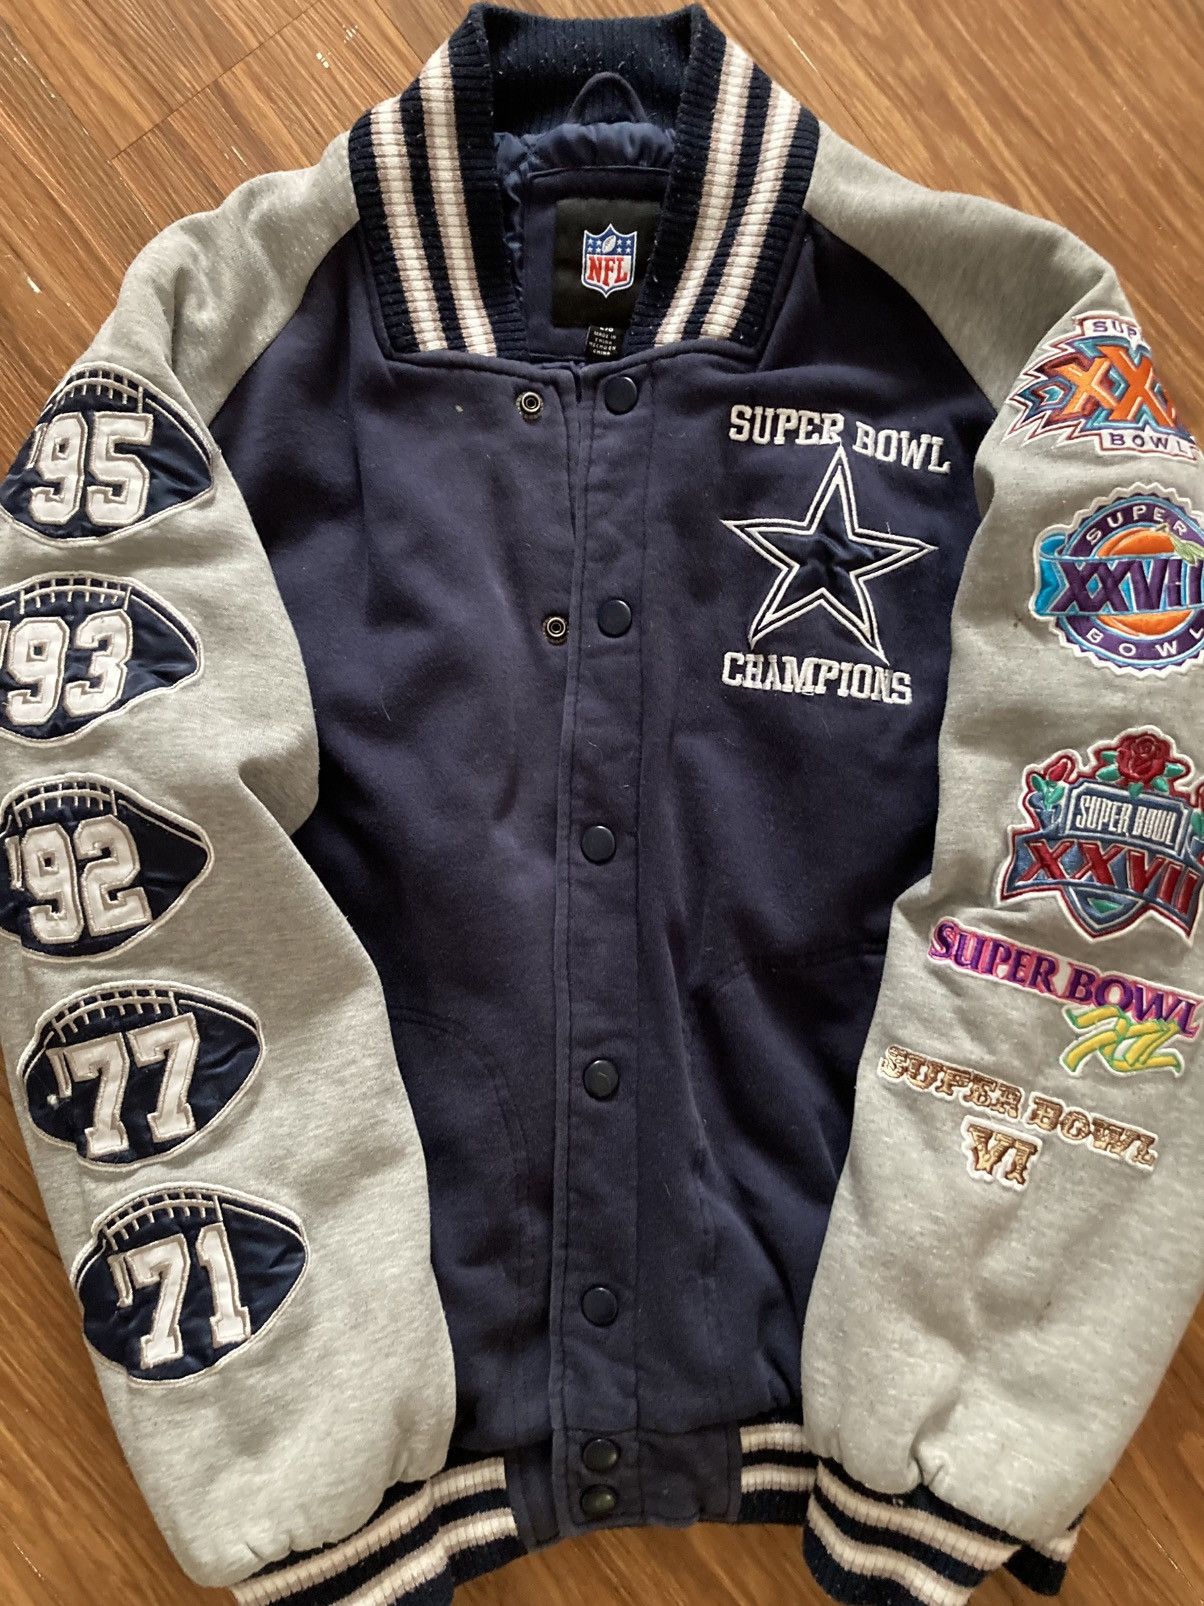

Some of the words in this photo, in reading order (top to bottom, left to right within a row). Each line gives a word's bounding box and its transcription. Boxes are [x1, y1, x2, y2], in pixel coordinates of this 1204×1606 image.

[587, 255, 628, 287] NFL
[1092, 320, 1138, 338] SUP
[1054, 346, 1177, 428] XX
[728, 403, 845, 446] SUPER
[852, 421, 950, 473] BOWL
[1110, 433, 1189, 453] BOWL
[1086, 505, 1188, 546] SUPER
[1086, 627, 1204, 658] BOWL
[721, 651, 913, 705] CHAMPIONS
[1075, 795, 1130, 835] SUPER
[1132, 803, 1177, 846] BOWL
[1014, 841, 1202, 915] XXVII
[929, 920, 1057, 996] SUPER
[1064, 965, 1201, 1038] BOWL
[880, 1045, 1024, 1119] SUPER
[1025, 1095, 1158, 1169] BOWL
[966, 1122, 1039, 1185] VI
